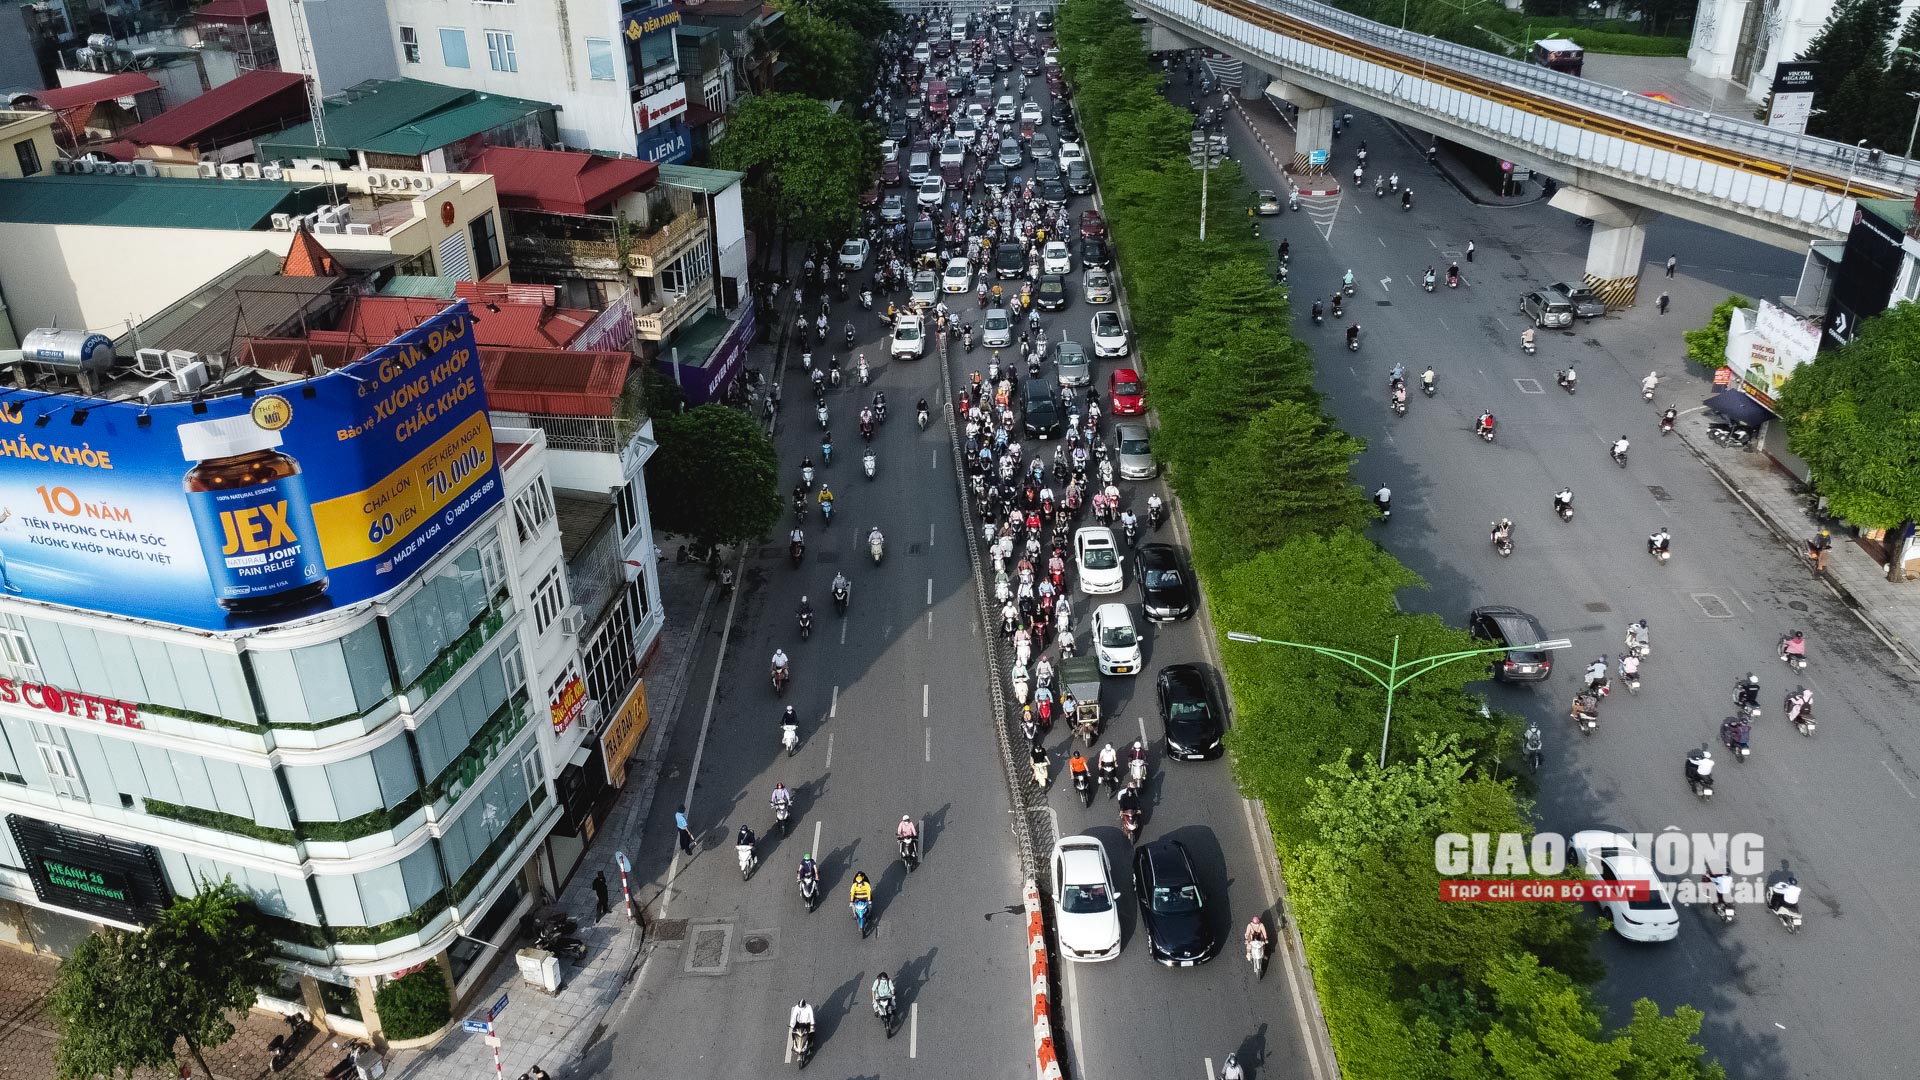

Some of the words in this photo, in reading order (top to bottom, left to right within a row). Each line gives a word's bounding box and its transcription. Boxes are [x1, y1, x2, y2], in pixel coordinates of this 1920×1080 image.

[661, 10, 680, 27] XANH
[337, 425, 362, 441] Bảo
[364, 416, 375, 430] vệ
[374, 376, 429, 423] XƯƠNG
[430, 348, 470, 387] KHỚP
[396, 402, 436, 442] CHẮC
[437, 376, 476, 415] KHỎE
[264, 410, 282, 424] MỚI
[50, 442, 113, 470] KHỎE
[421, 454, 439, 475] TIẾT
[440, 441, 460, 462] KIỆM
[461, 424, 482, 445] NGAY
[36, 485, 81, 516] 10
[84, 500, 132, 523] NĂM
[230, 491, 254, 500] NATURAL
[255, 486, 277, 496] ESSENCE
[363, 493, 390, 514] CHAI
[392, 476, 411, 497] LỚN
[454, 500, 470, 517] 1800
[470, 490, 482, 505] 556
[482, 480, 495, 495] 889
[21, 516, 50, 530] TIÊN
[52, 521, 97, 537] PHONG
[100, 528, 138, 543] CHĂM
[139, 532, 167, 547] SÓC
[220, 500, 298, 554] JEX
[368, 512, 394, 544] 60
[395, 505, 416, 526] VIÊN
[28, 534, 69, 549] XƯƠNG
[71, 541, 104, 554] KHỚP
[107, 546, 144, 561] NGƯỜI
[146, 552, 172, 566] VIỆT
[227, 555, 264, 568] NATURAL
[268, 545, 301, 562] JOINT
[394, 541, 416, 564] MADE
[417, 534, 425, 546] IN
[426, 523, 441, 539] USA
[238, 567, 262, 577] PAIN
[264, 559, 295, 574] RELIEF
[304, 563, 316, 576] 60
[277, 580, 288, 588] USA
[21, 681, 143, 730] COFFEE
[44, 861, 88, 880] THEANH
[90, 873, 104, 885] 28
[49, 874, 125, 900] Entertainment
